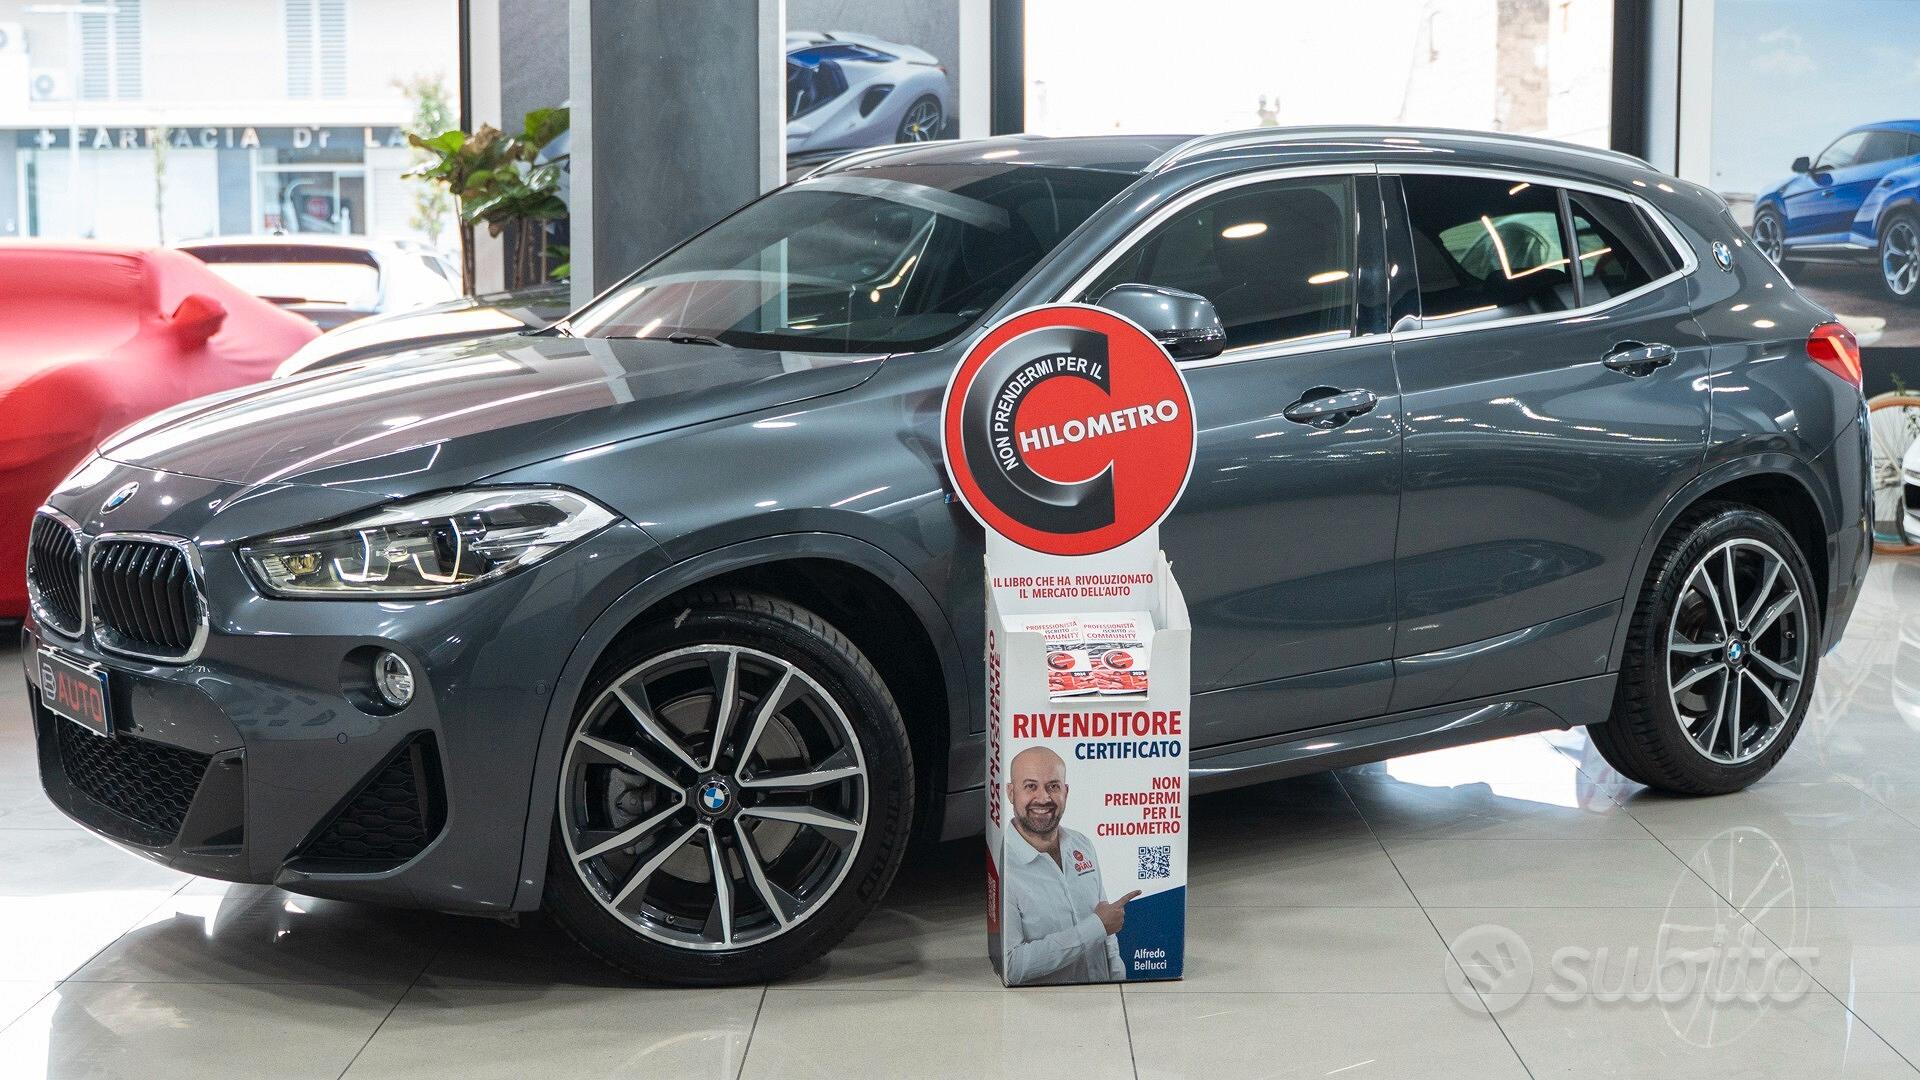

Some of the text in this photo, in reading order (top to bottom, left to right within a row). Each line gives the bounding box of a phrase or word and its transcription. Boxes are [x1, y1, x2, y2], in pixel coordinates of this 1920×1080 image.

[995, 356, 1102, 471] NON PRENDERMI PER IL
[1019, 399, 1179, 453] HILOMETRO
[993, 573, 1154, 588] IL LIBRO CHE HA RIVOLUZIONATO
[1019, 586, 1131, 599] IL MERCATO DELL'AUTO
[58, 671, 104, 723] AUTO
[1013, 710, 1182, 739] RIVENDITORE
[1074, 740, 1182, 760] CERTIFICATO
[1152, 776, 1181, 790] NON
[1104, 792, 1181, 807] PRENDERMI
[1142, 806, 1181, 820] PER IL
[1097, 821, 1181, 837] CHILOMETRO
[1134, 948, 1166, 959] Alfredo
[1134, 959, 1167, 971] Bellucci
